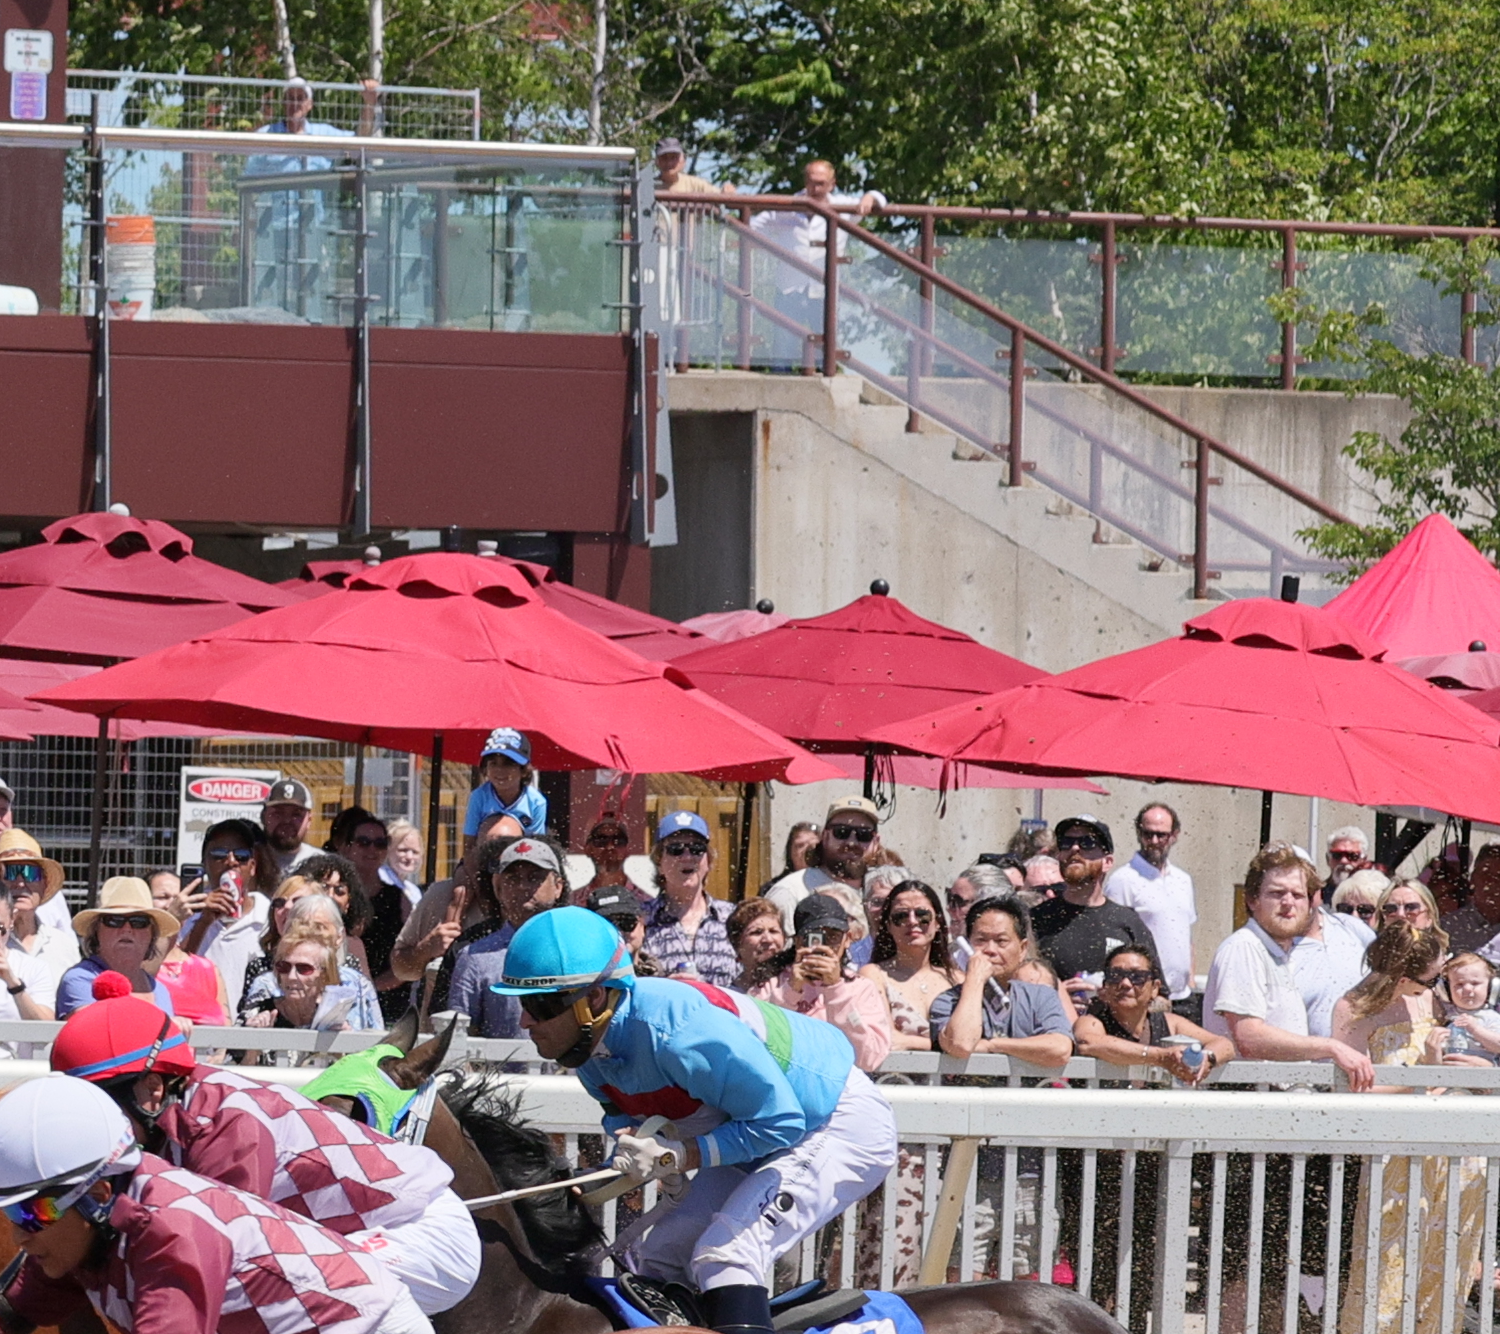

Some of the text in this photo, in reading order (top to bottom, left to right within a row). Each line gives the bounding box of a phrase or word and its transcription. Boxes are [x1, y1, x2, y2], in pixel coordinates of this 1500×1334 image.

[201, 782, 262, 799] DANGER
[283, 784, 295, 799] 3
[192, 807, 262, 819] CONSTRUCTIO
[524, 978, 556, 986] SHOP
